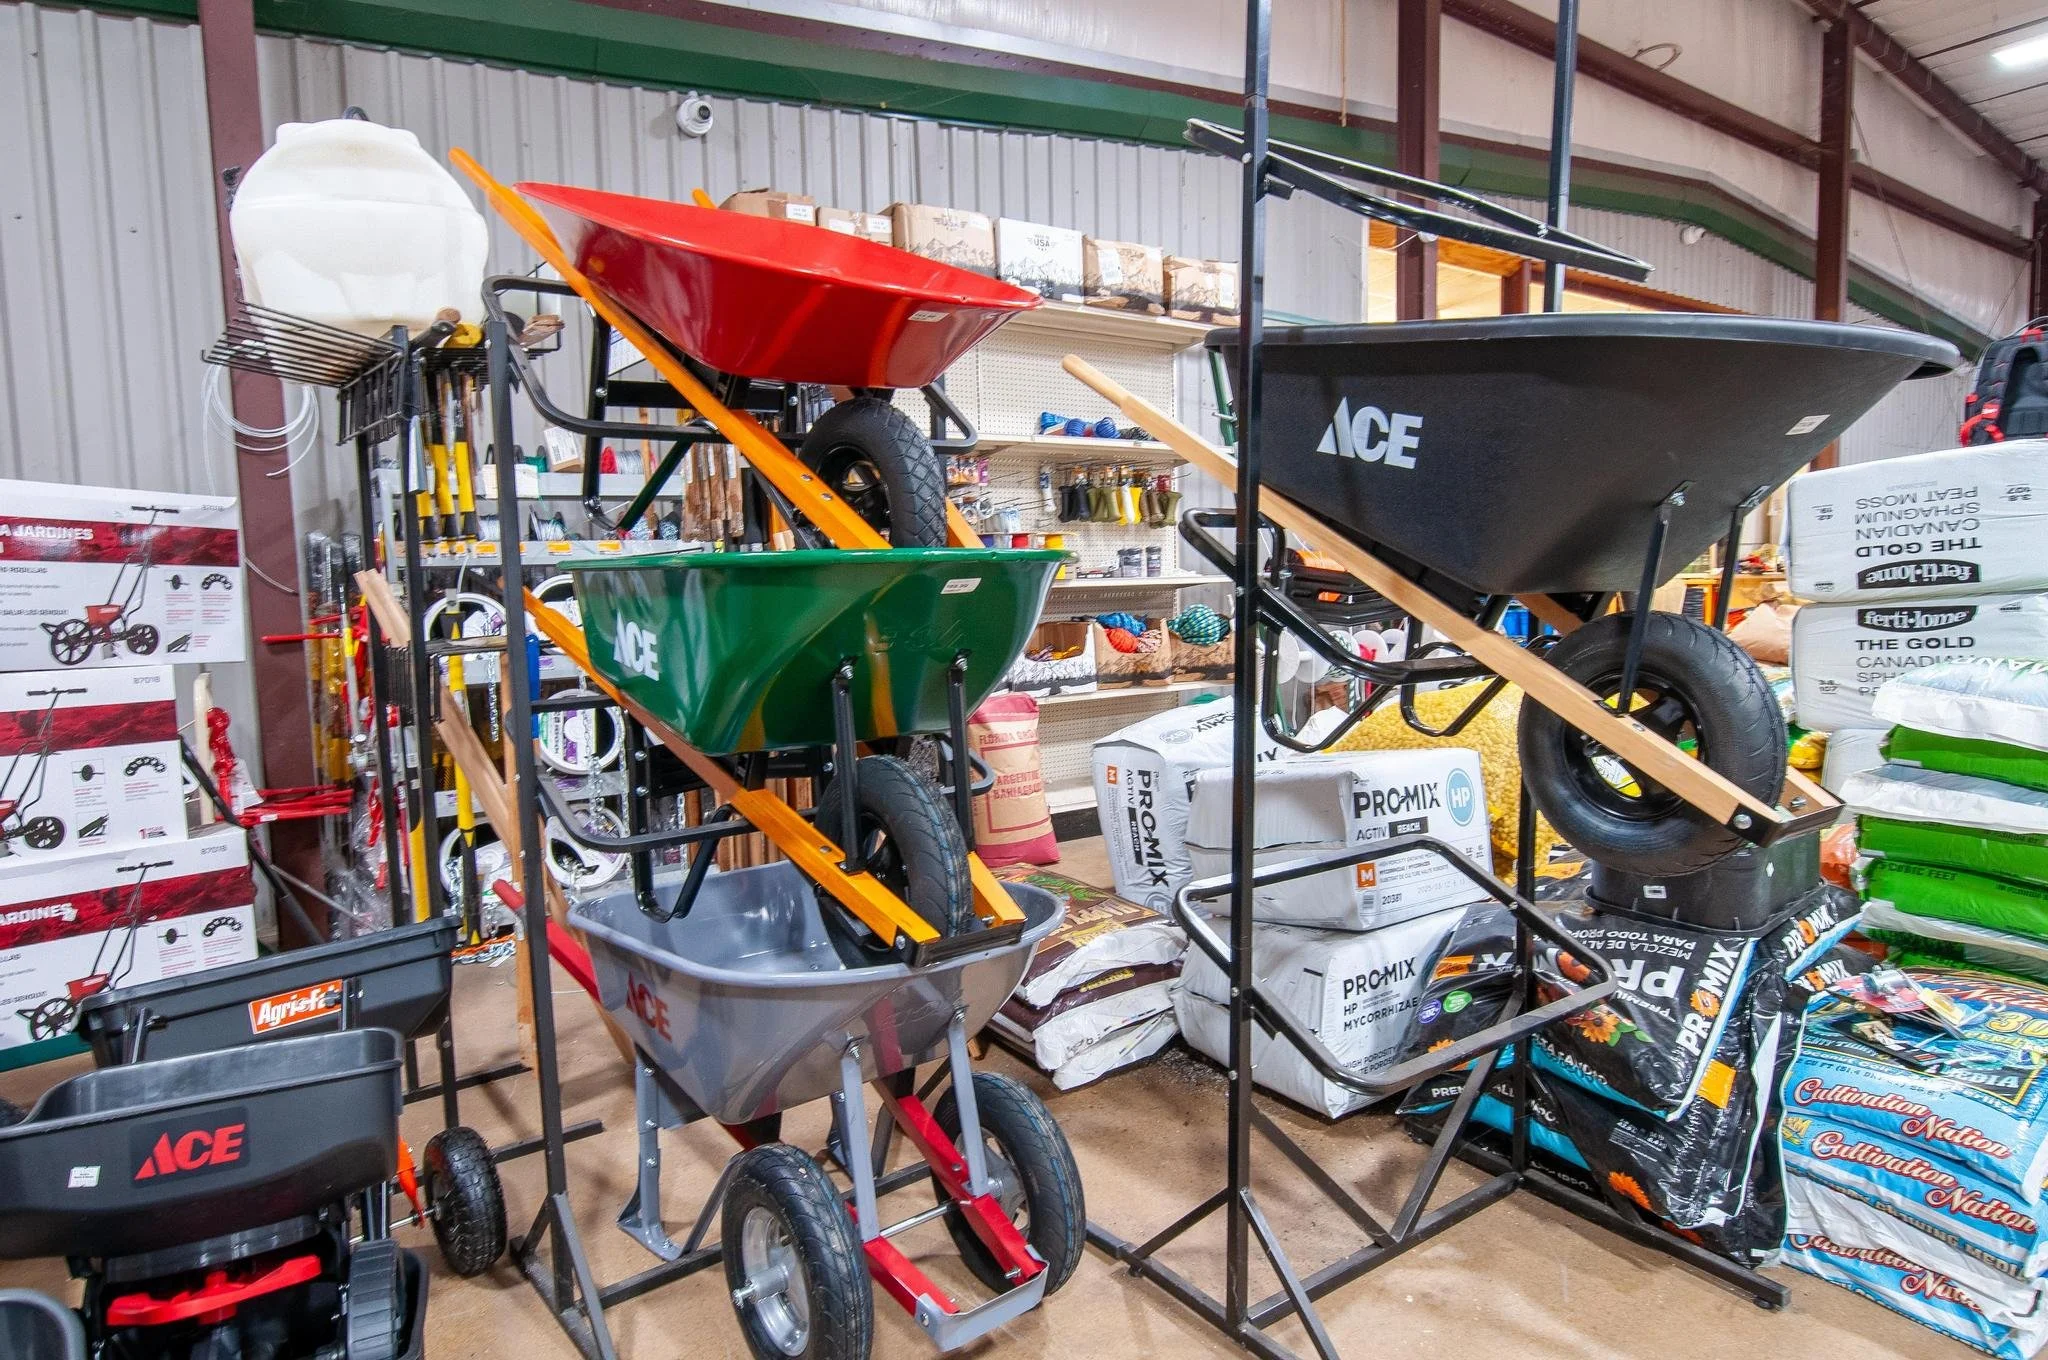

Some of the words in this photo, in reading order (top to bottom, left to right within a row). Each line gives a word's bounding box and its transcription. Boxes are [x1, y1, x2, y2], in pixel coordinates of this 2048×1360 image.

[1034, 237, 1050, 247] USA
[1317, 396, 1423, 469] ACE
[1856, 493, 1917, 509] MOSS
[1923, 486, 1979, 502] PEAT
[1855, 502, 1981, 524] SPHAGNUM
[13, 525, 93, 540] JARDINES
[1856, 518, 1981, 540] CANADIAN
[1856, 542, 1923, 558] GOLD
[1931, 537, 1982, 552] THE
[614, 611, 660, 682] ACE
[1856, 639, 1899, 650] THE
[1907, 636, 1975, 649] GOLD
[1450, 787, 1471, 809] HP
[1360, 868, 1374, 882] M
[1606, 940, 1627, 949] DE
[1607, 931, 1649, 941] TODO
[1652, 933, 1697, 949] PARA
[1630, 942, 1693, 960] MEZCLA
[625, 969, 673, 1043] ACE
[1343, 1003, 1358, 1016] HP
[1343, 996, 1419, 1032] MYCORRHIZAE
[1364, 1044, 1399, 1064] POROSITY
[1793, 1077, 1931, 1118] Cultivation
[1901, 1114, 2012, 1159] Nation
[134, 1123, 246, 1181] ACE
[1811, 1131, 1958, 1190] Cultivation
[1925, 1186, 2038, 1235] Nation
